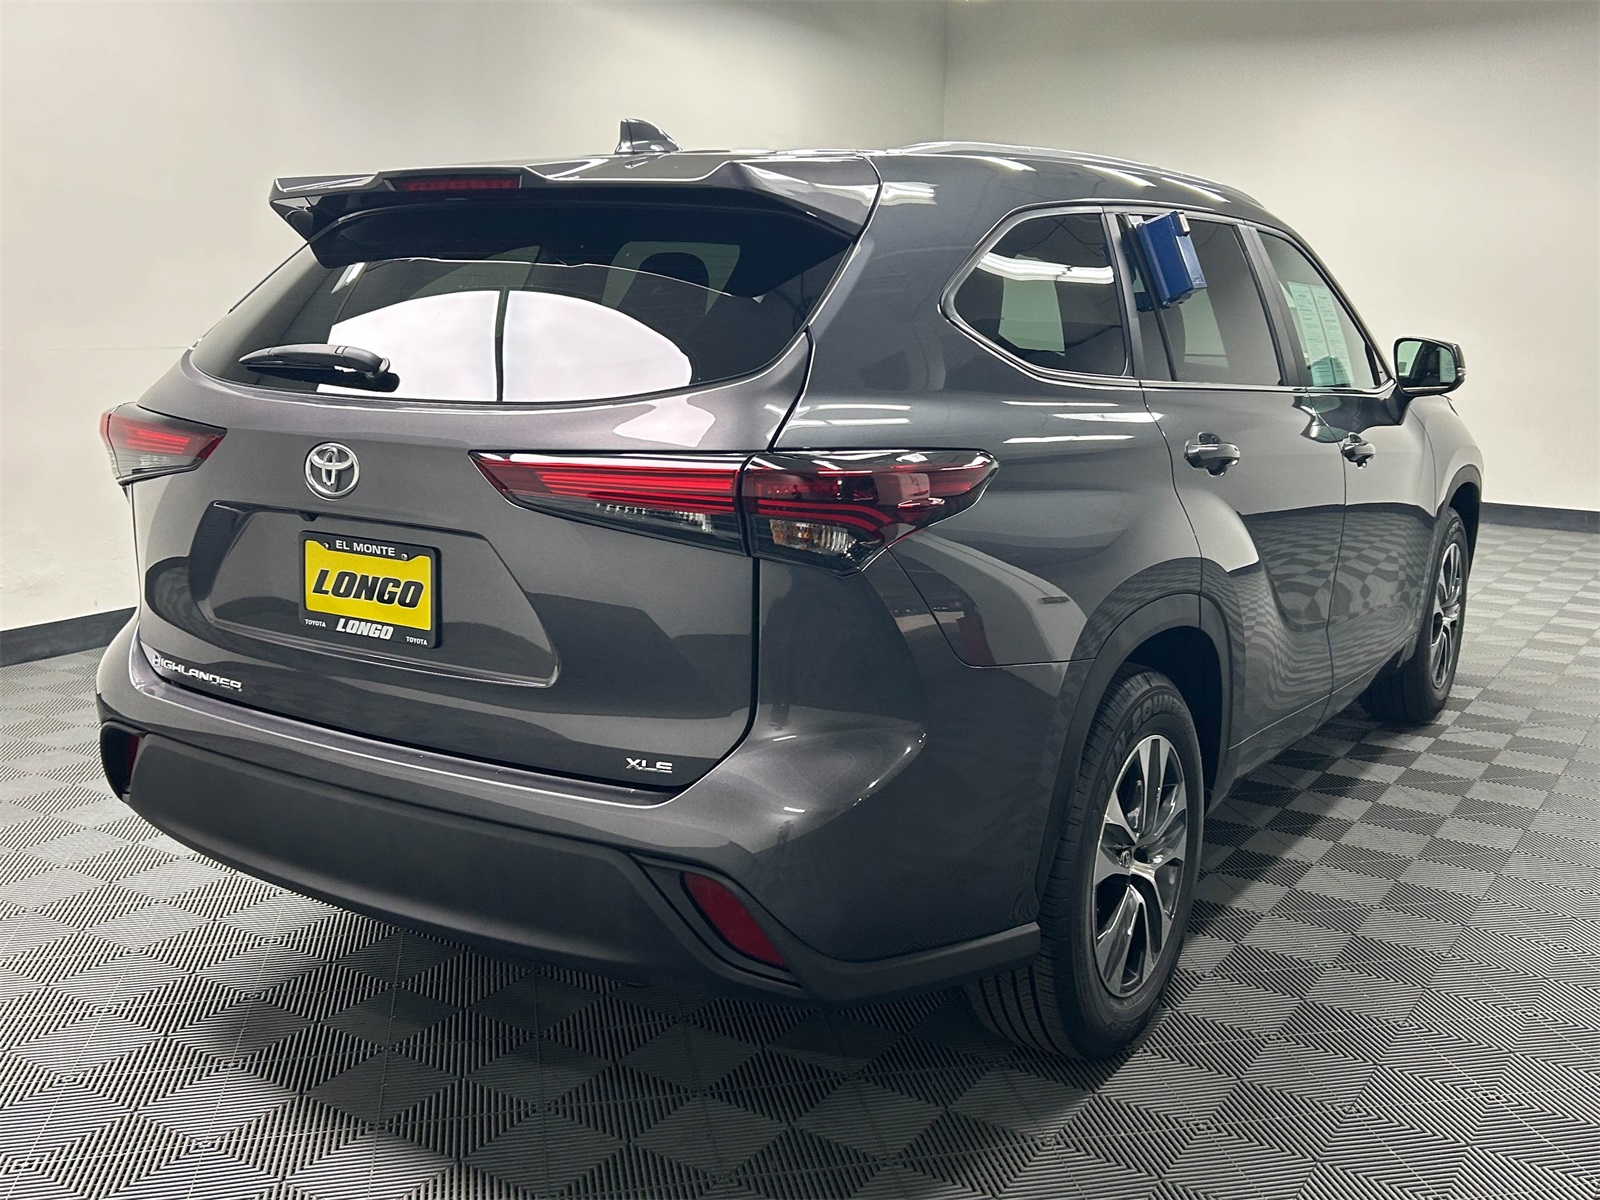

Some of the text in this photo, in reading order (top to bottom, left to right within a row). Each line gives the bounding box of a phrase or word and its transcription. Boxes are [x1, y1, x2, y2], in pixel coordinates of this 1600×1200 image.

[335, 540, 396, 557] EL MONTE
[311, 568, 425, 609] LONGO
[304, 618, 327, 628] TOYOTA
[335, 617, 395, 640] LONGO
[405, 635, 428, 646] TOYOTA
[153, 654, 243, 692] HIGHLANDER
[625, 757, 673, 774] XLE
